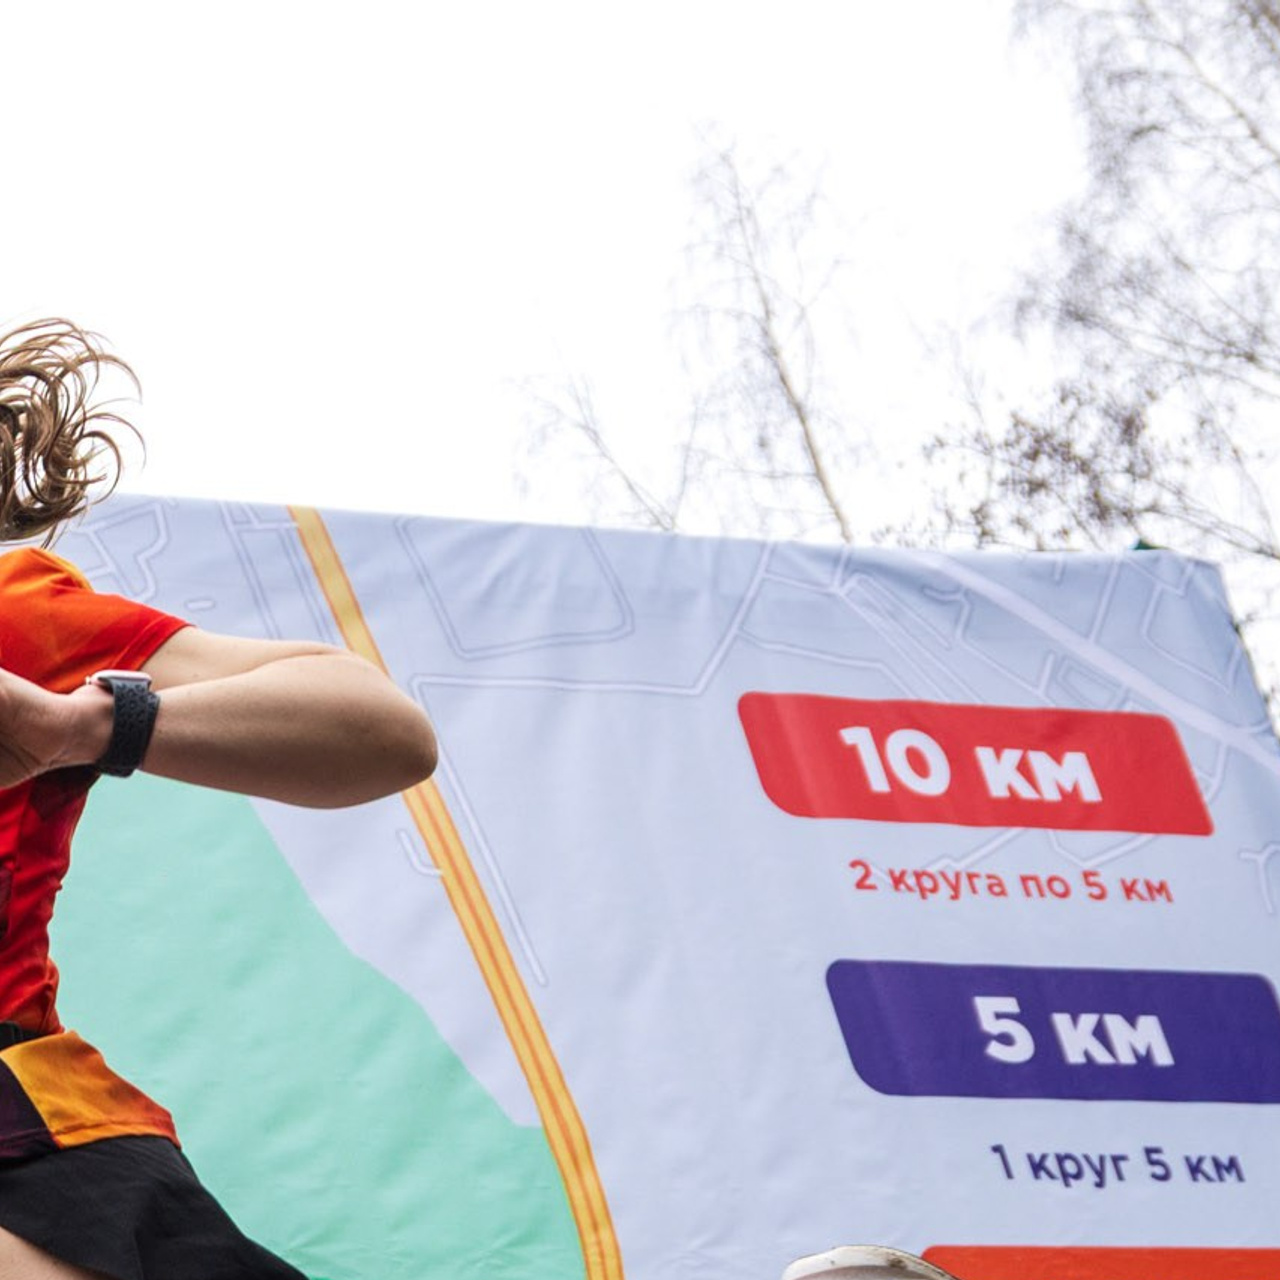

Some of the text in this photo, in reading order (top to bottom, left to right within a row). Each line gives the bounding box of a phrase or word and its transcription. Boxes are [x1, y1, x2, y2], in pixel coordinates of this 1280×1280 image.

[838, 726, 952, 797] 10
[849, 860, 1174, 903] 2 круга по 5 км
[973, 996, 1035, 1063] 5
[991, 1145, 1246, 1188] 1 круг 5 км
